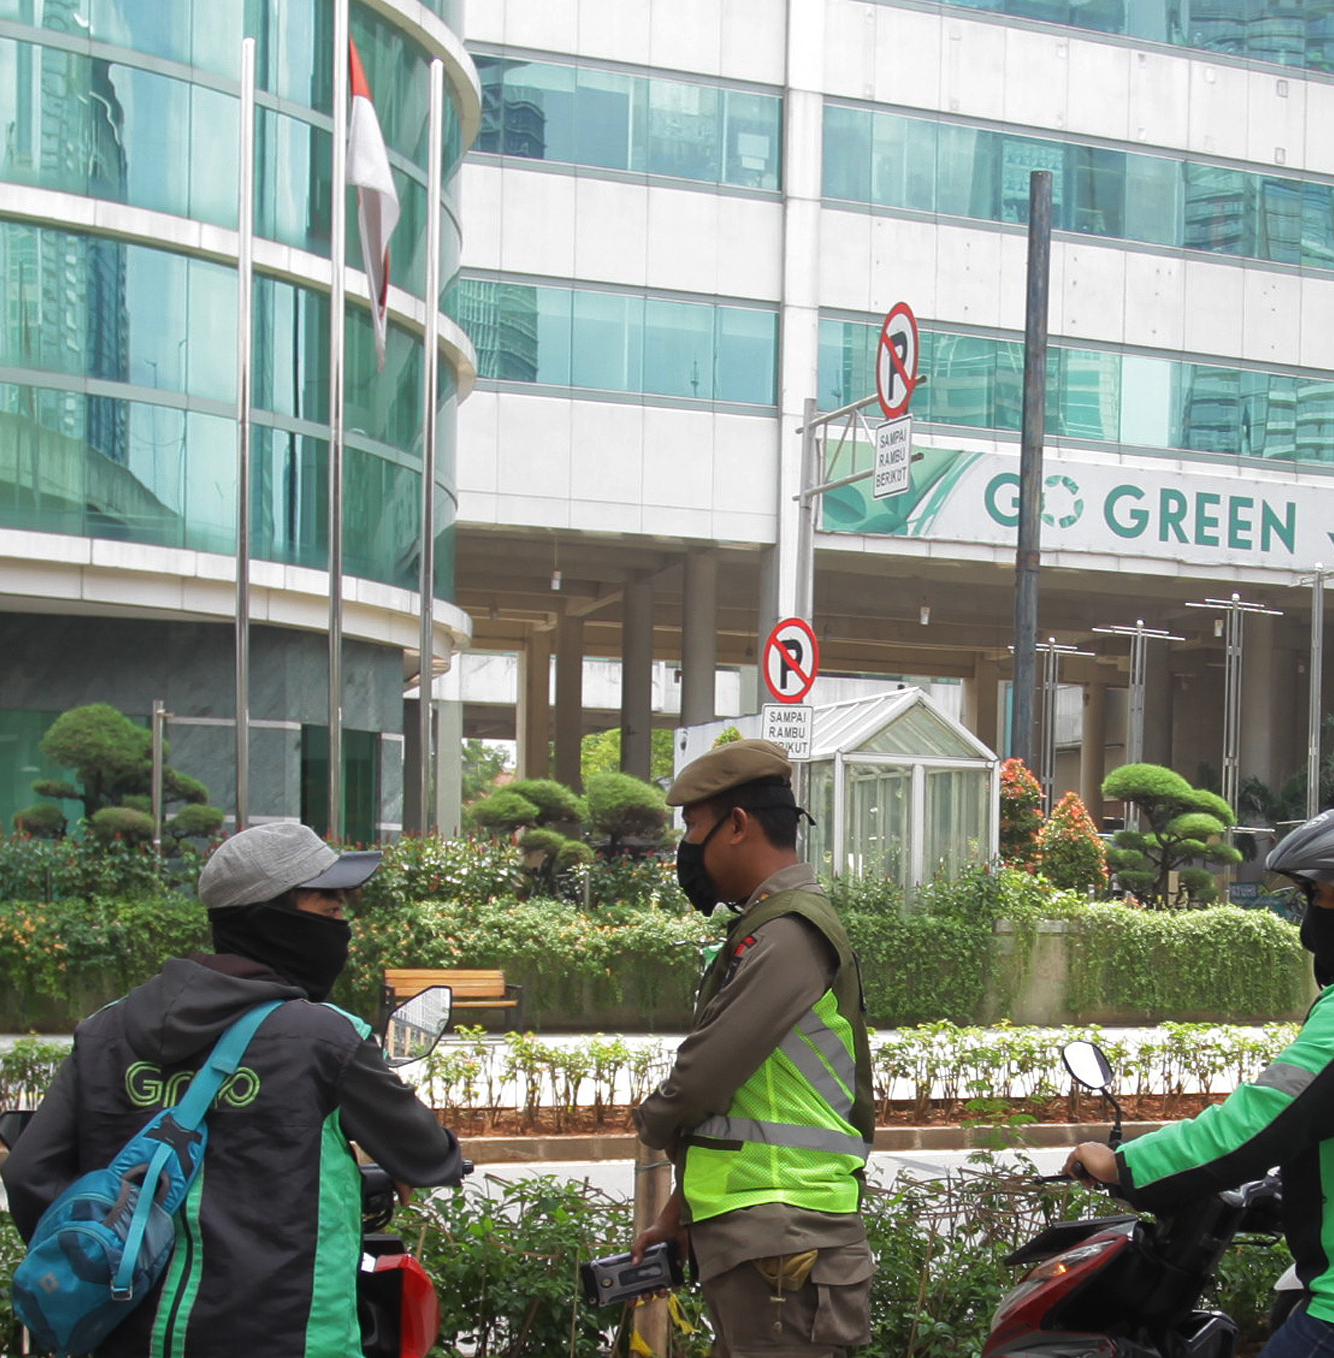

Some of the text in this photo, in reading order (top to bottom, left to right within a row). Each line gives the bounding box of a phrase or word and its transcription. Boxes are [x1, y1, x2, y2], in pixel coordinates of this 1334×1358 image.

[879, 429, 906, 448] SAMPAI
[878, 449, 906, 467] RAMBU
[876, 467, 907, 488] BERIKUT
[1103, 484, 1296, 554] GREEN
[769, 711, 806, 723] SAMPAI
[768, 726, 806, 739] RAMBU
